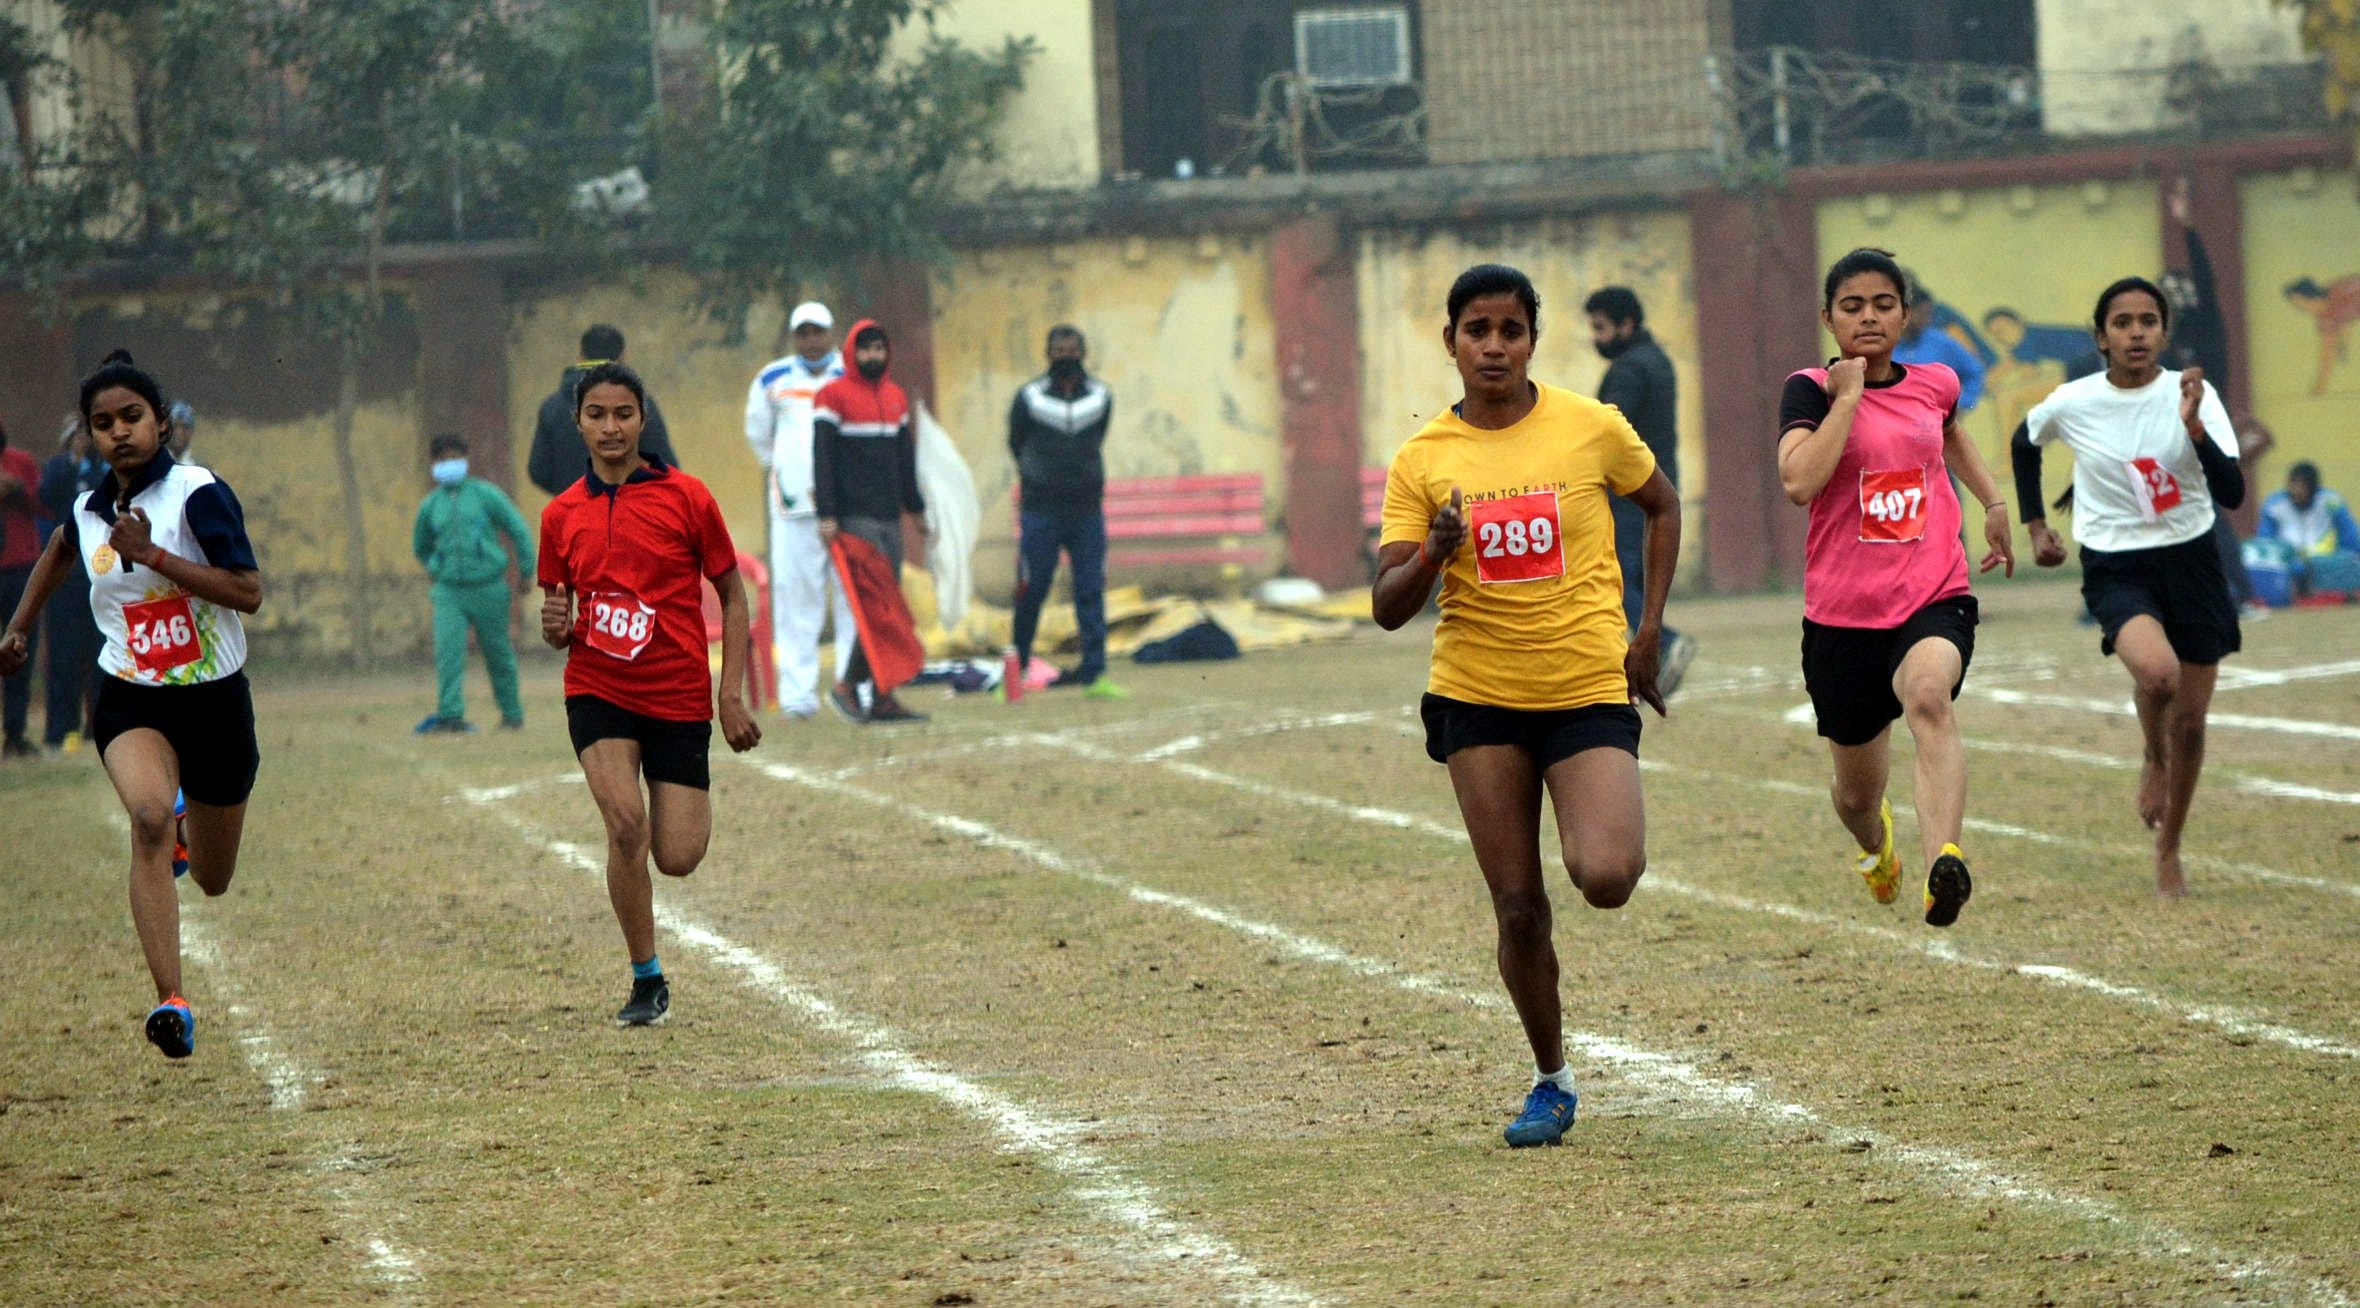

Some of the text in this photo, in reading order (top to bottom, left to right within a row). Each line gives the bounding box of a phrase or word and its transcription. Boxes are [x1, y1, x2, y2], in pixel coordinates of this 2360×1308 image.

[1463, 490, 1496, 504] OWN
[1501, 487, 1518, 498] TO
[1869, 487, 1922, 523] 407
[1479, 516, 1554, 558] 289
[131, 614, 192, 656] 546
[595, 602, 649, 643] 268
